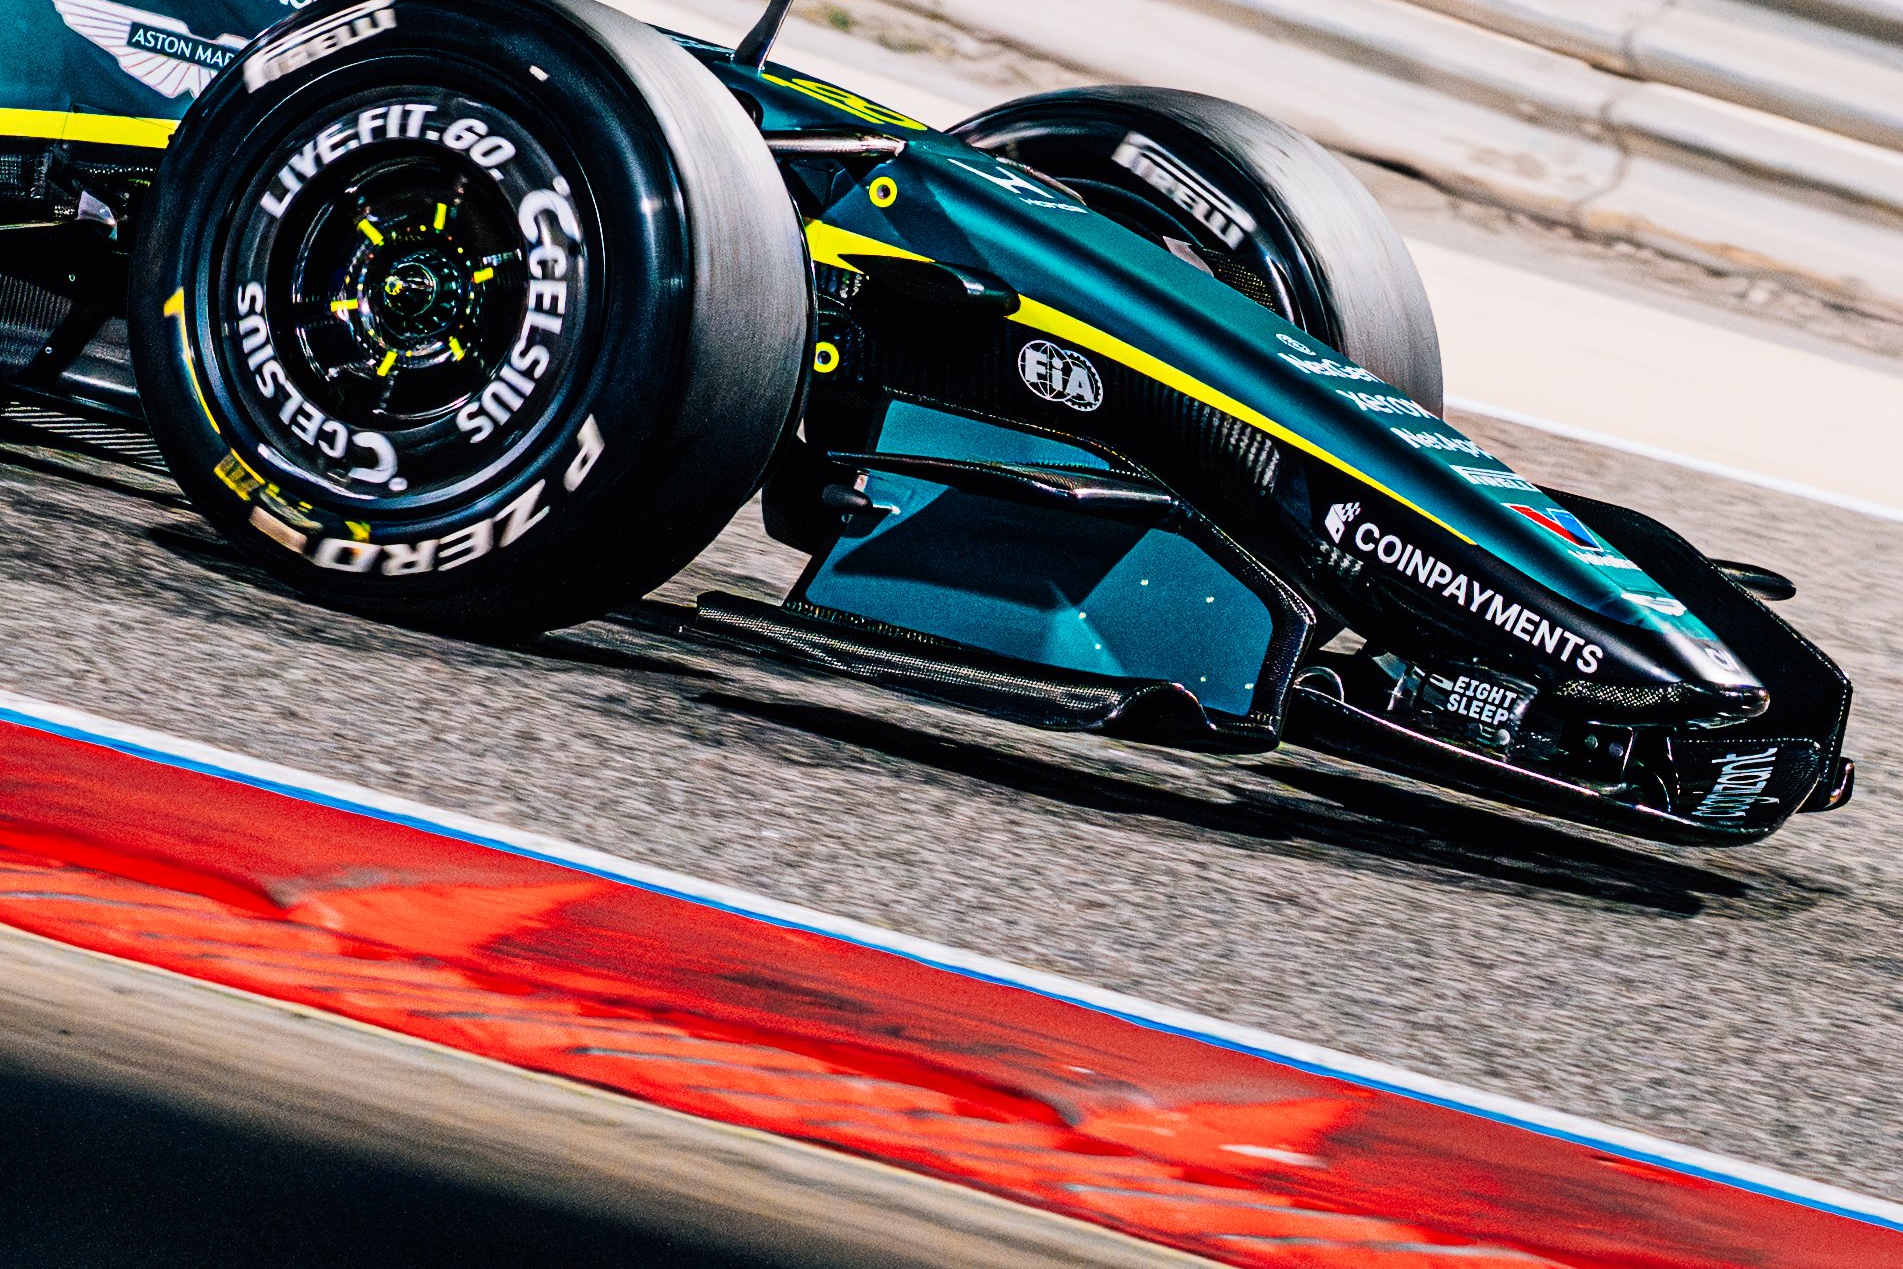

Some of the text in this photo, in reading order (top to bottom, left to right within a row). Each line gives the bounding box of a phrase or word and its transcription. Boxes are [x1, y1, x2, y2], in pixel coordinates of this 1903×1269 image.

[132, 28, 192, 58] ASTON
[237, 281, 349, 459] CELSIUS
[456, 244, 568, 444] CELSIUS
[1354, 522, 1604, 674] COINPAYMENTS
[1446, 693, 1510, 727] SLEEP
[1453, 675, 1518, 709] EIGHT
